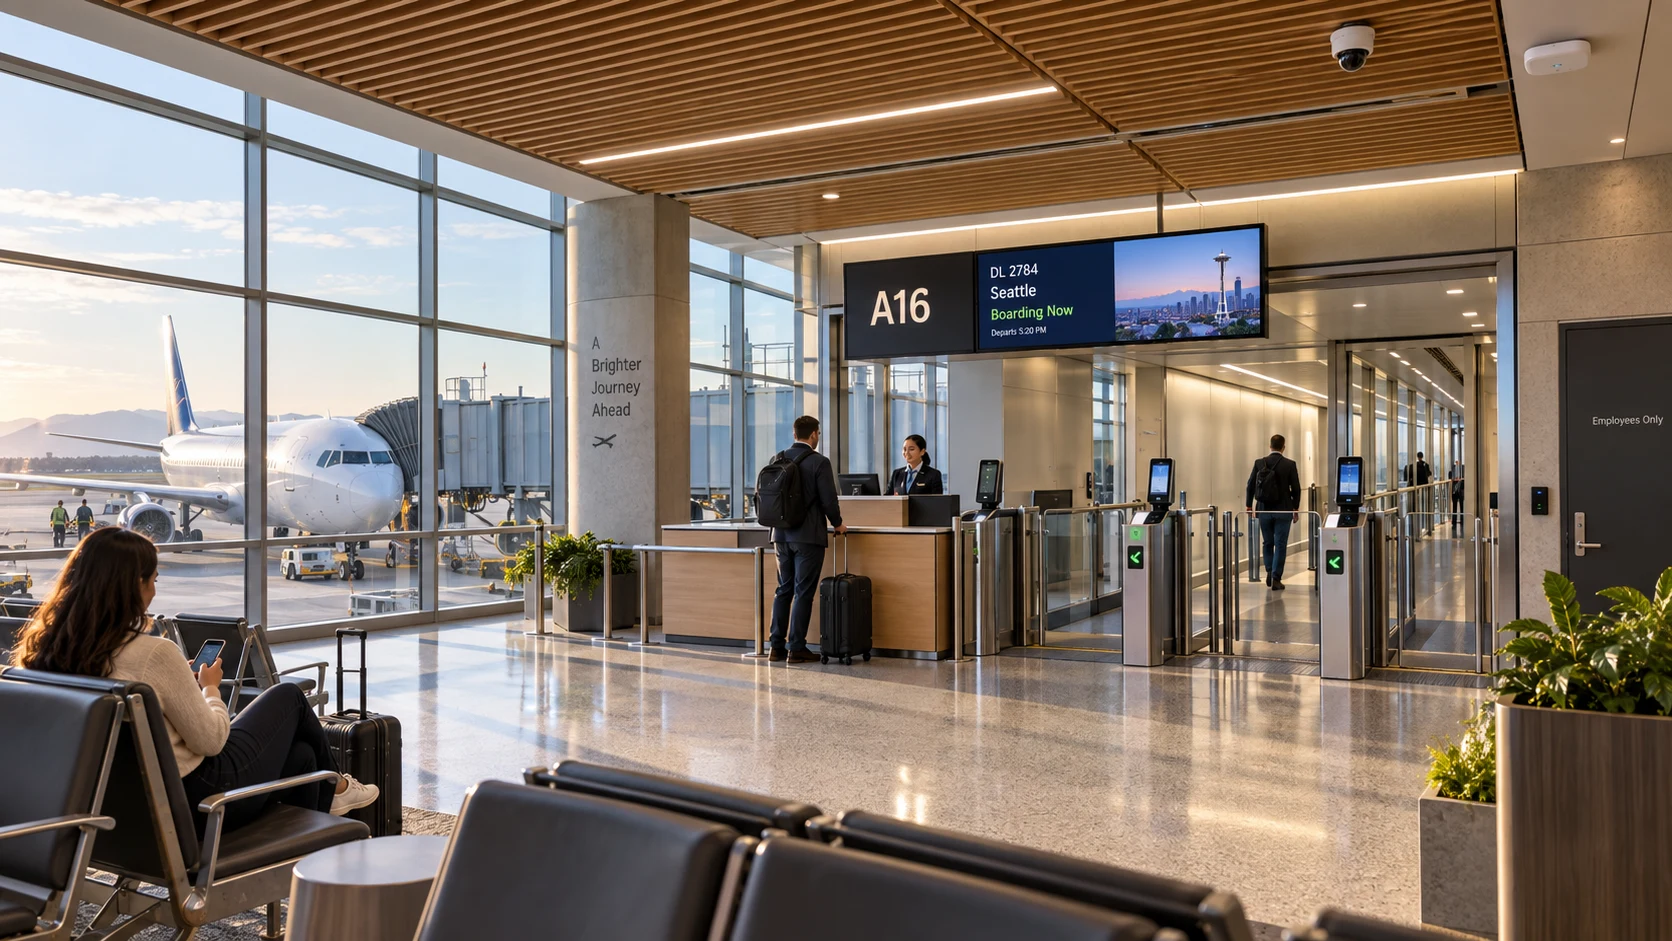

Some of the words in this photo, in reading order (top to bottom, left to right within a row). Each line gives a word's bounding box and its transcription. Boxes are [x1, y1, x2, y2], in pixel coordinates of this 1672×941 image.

[990, 265, 1006, 279] DL
[1009, 263, 1039, 277] 2784
[990, 283, 1037, 300] Seattle
[870, 287, 931, 326] A16
[991, 306, 1044, 321] Boarding
[1047, 304, 1074, 317] Now
[991, 328, 1017, 338] Departs
[1035, 325, 1047, 334] PM
[591, 336, 601, 350] A
[592, 357, 642, 376] Brighter
[591, 380, 641, 397] Journey
[591, 401, 631, 417] Ahead
[1592, 414, 1641, 427] Employees
[1642, 414, 1664, 426] Only
